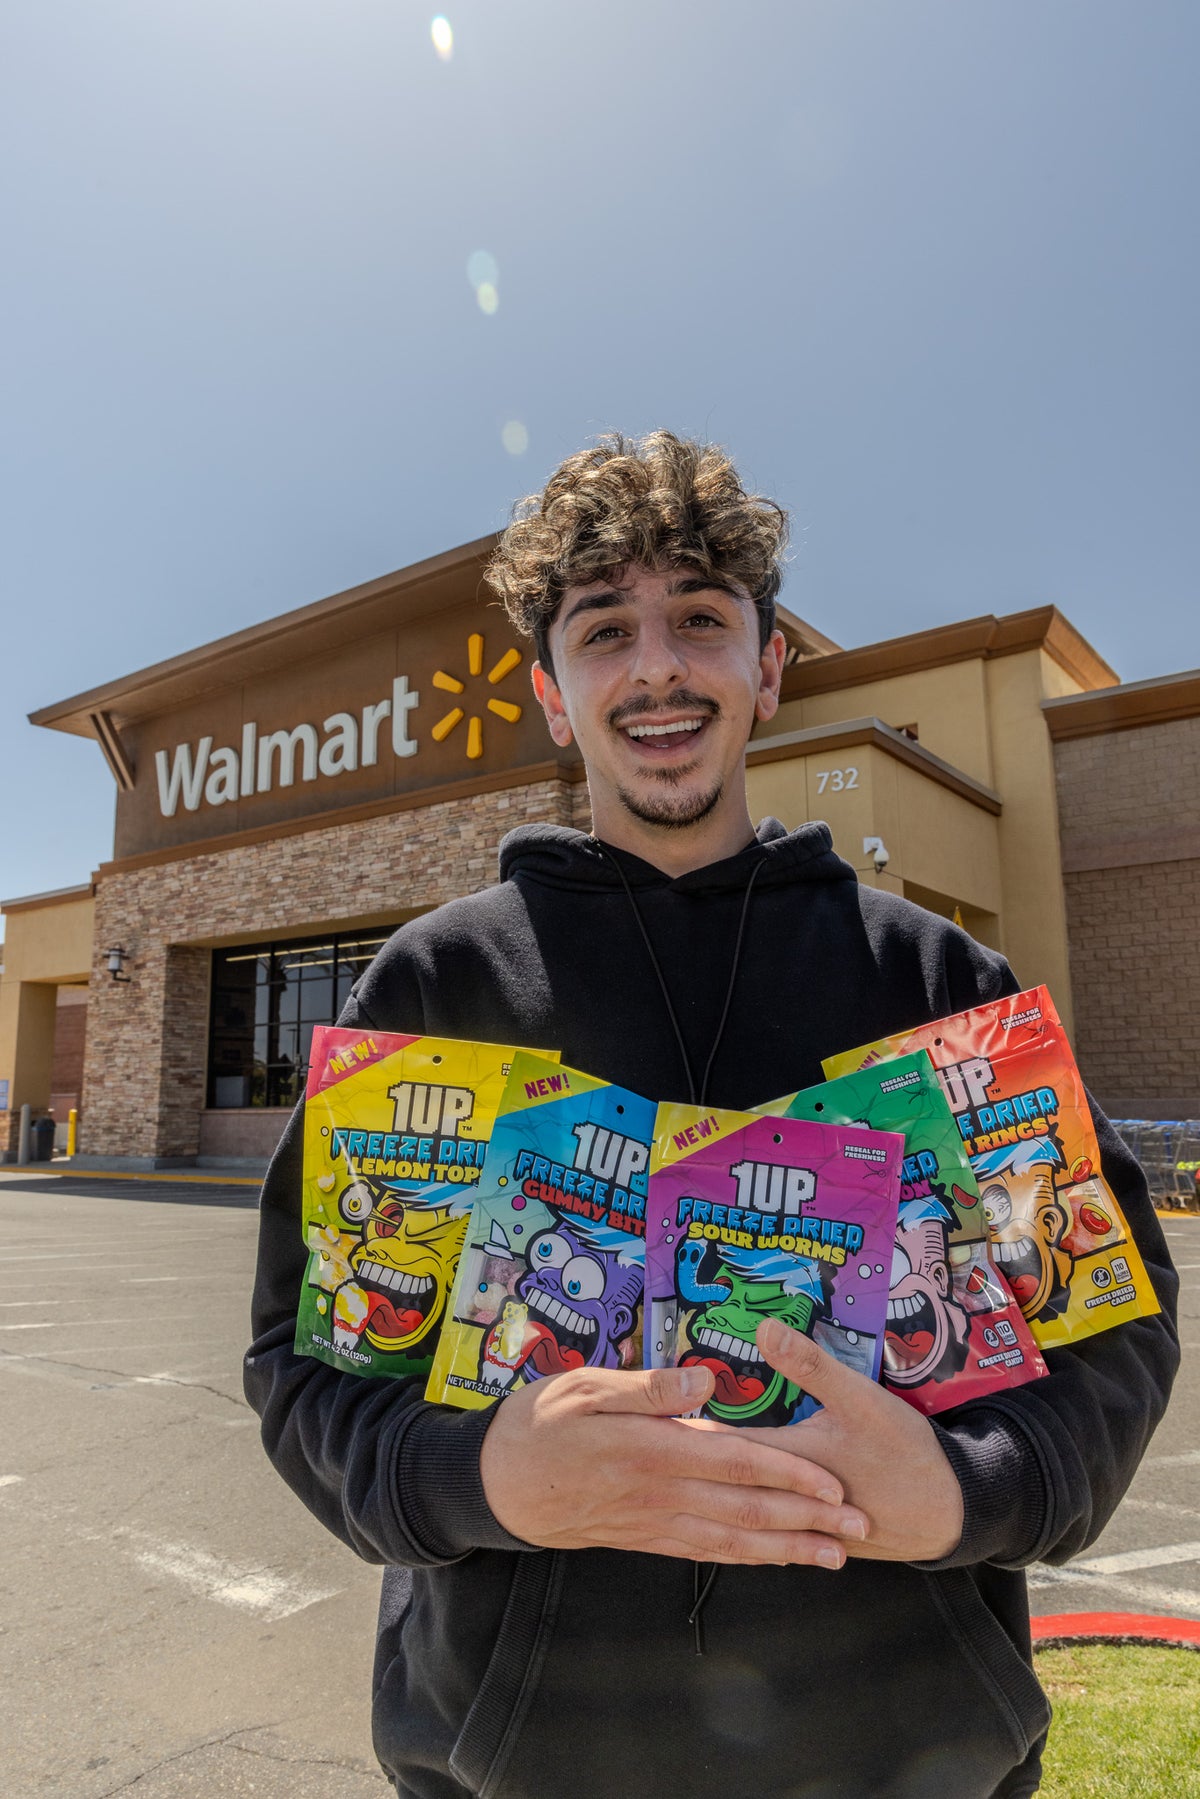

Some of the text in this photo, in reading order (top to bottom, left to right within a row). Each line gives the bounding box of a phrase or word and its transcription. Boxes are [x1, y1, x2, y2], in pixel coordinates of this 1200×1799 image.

[155, 675, 419, 817] Walmart
[816, 767, 859, 794] 732
[1026, 1007, 1040, 1017] FOR
[329, 1038, 379, 1076] NEW!
[524, 1073, 570, 1099] NEW!
[880, 1071, 919, 1088] RESEAL FOR
[882, 1077, 921, 1093] FRESHNESS
[389, 1083, 475, 1136] 1UP
[977, 1088, 1057, 1134] DRIED
[673, 1116, 720, 1150] NEW!
[974, 1117, 1049, 1153] RINGS
[332, 1130, 489, 1168] FREEZE DRI
[573, 1122, 650, 1188] 1UP
[844, 1145, 886, 1157] RESEAL FOR
[844, 1152, 886, 1162] FRESHNESS
[352, 1157, 483, 1183] LEMON TOP
[516, 1152, 609, 1208] FREEZE
[730, 1161, 817, 1215] 1UP
[523, 1180, 647, 1237] GUMMY BIT
[678, 1198, 864, 1256] FREEZE DRIED
[688, 1222, 847, 1265] SOUR WORMS
[1114, 1262, 1124, 1272] 110
[1085, 1285, 1134, 1308] FREEZE DRIED
[1111, 1291, 1136, 1306] CANDY
[997, 1324, 1010, 1335] 110
[341, 1348, 350, 1357] OZ
[350, 1350, 372, 1364] (120g)
[447, 1375, 463, 1386] NET
[464, 1378, 477, 1390] WT
[477, 1383, 489, 1394] 2.0
[490, 1386, 501, 1396] OZ
